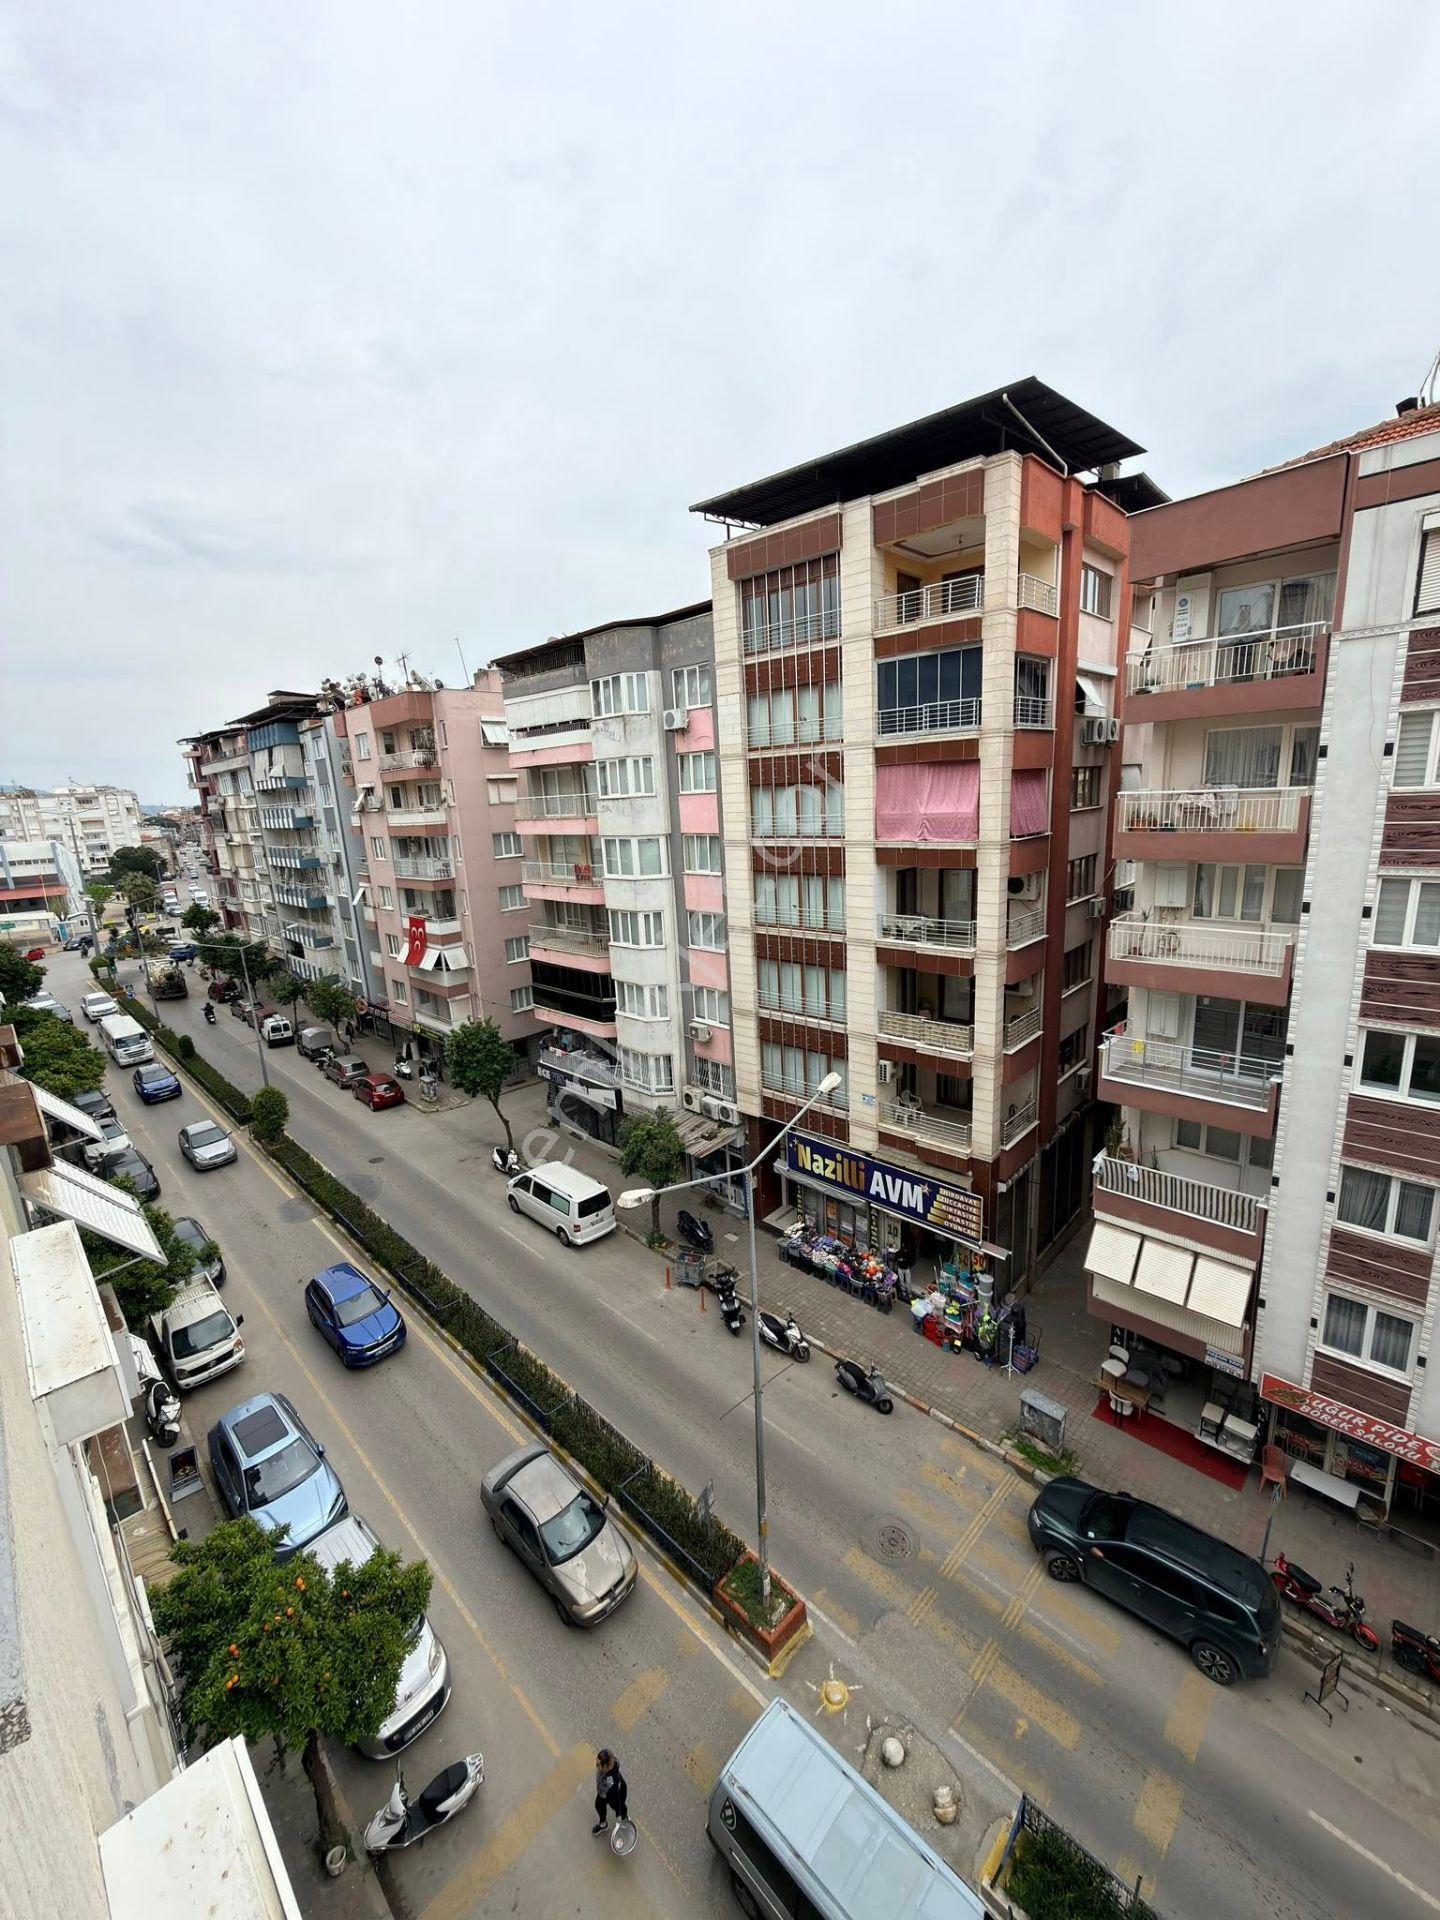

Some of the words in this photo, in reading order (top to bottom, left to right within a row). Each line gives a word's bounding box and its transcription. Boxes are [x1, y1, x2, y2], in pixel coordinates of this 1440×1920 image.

[797, 1145, 866, 1191] Nazilli
[870, 1170, 924, 1213] AVM
[1300, 1404, 1353, 1431] BÖREK
[1355, 1427, 1422, 1460] SALONU
[1313, 1399, 1367, 1427] UĞUR
[1371, 1424, 1424, 1451] PİDE
